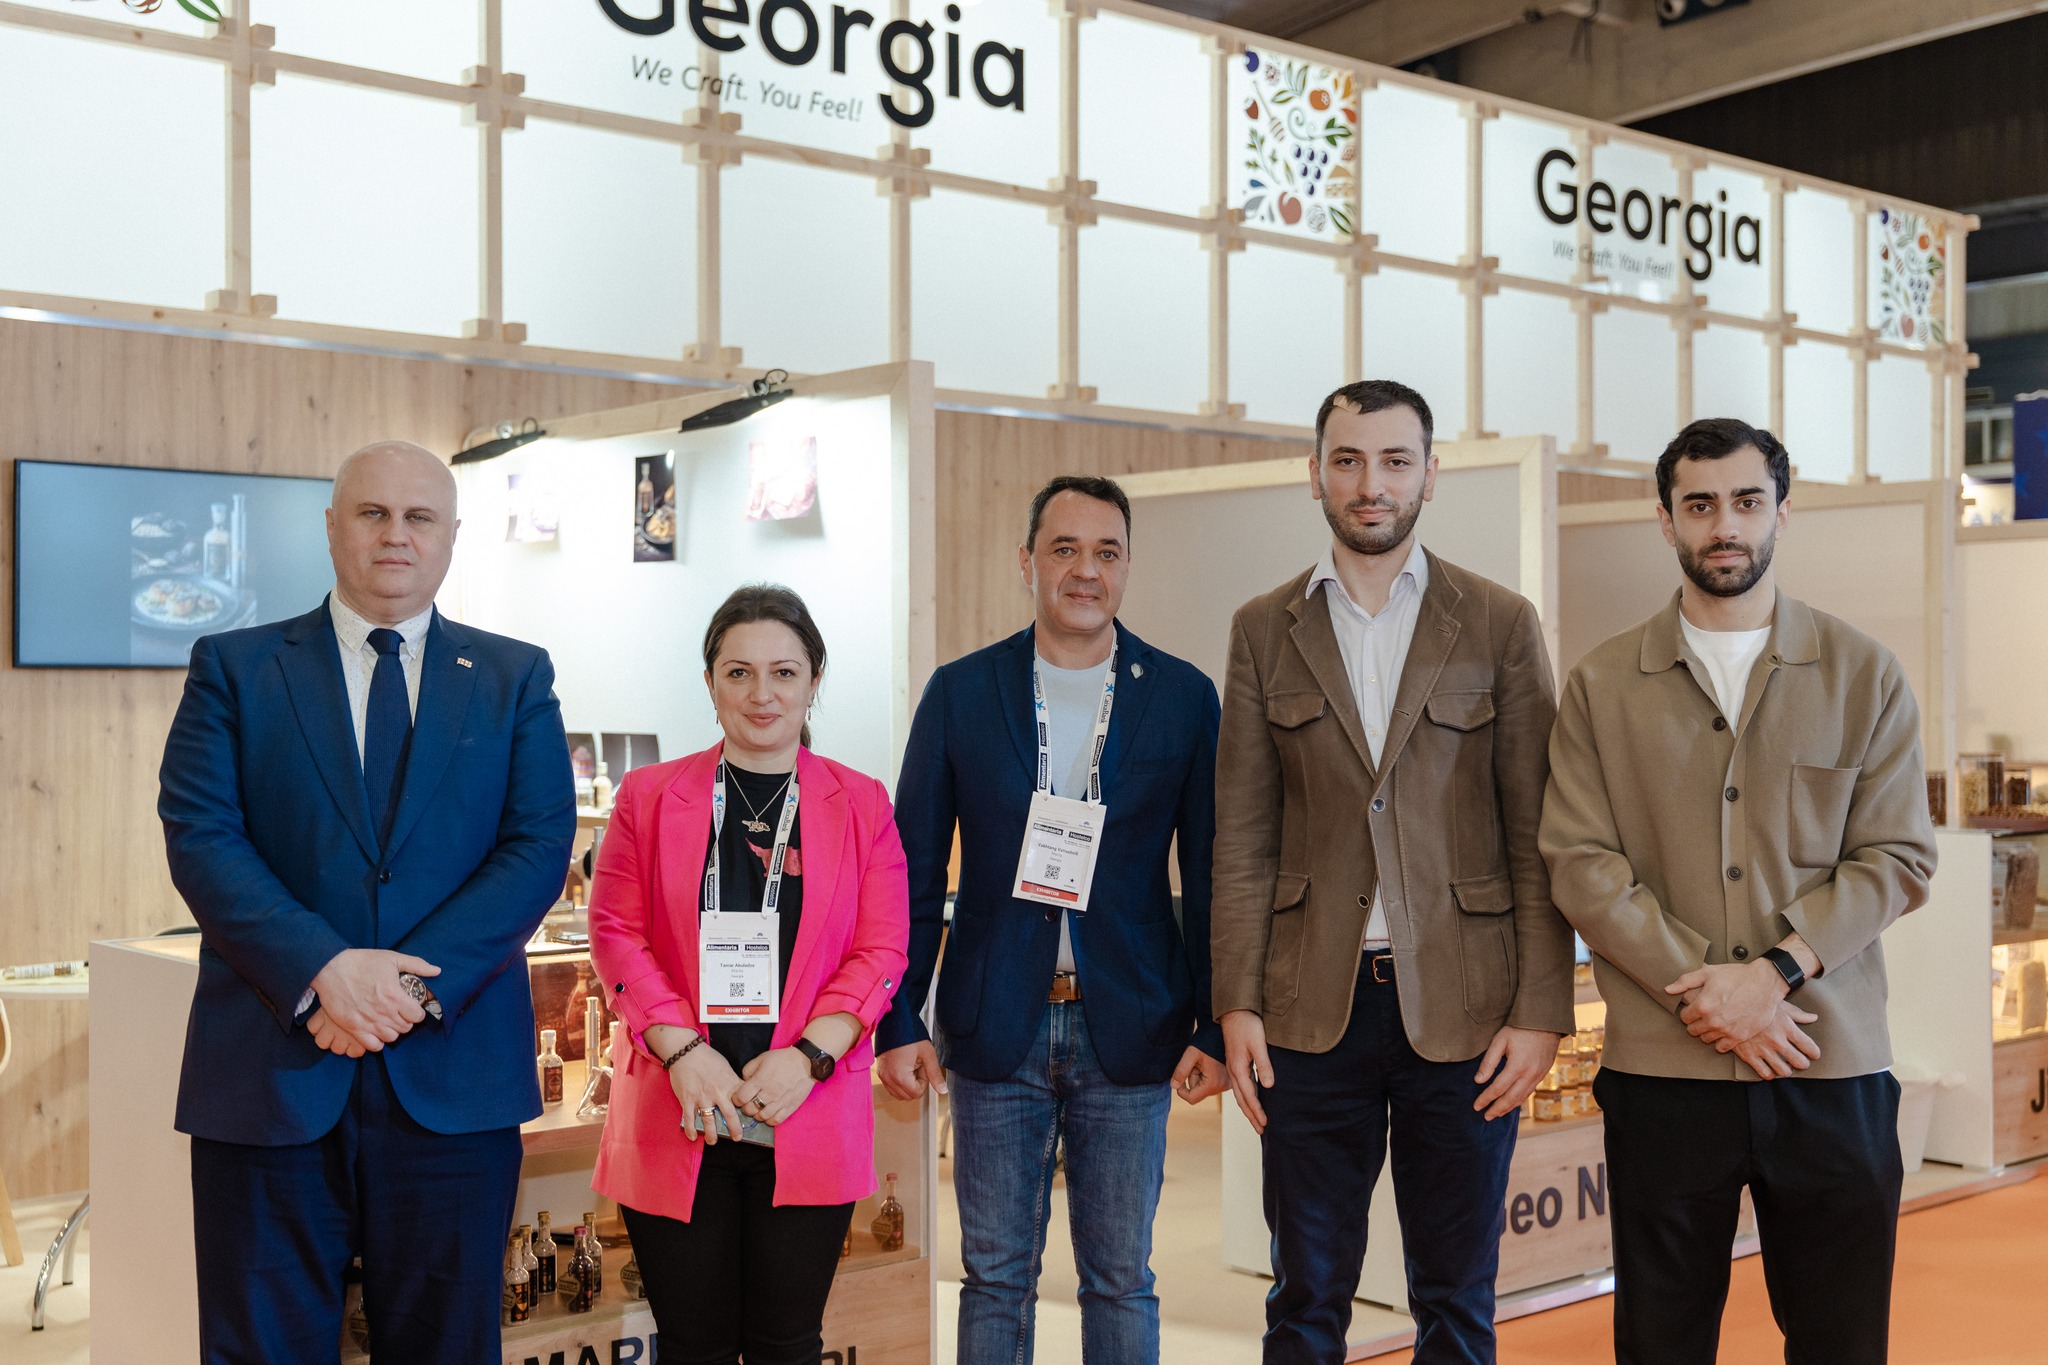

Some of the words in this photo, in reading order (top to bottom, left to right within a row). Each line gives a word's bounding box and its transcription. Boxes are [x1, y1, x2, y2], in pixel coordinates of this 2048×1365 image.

[631, 54, 673, 86] We
[681, 66, 747, 102] Craft.
[759, 80, 801, 110] You
[808, 91, 864, 123] Feel!
[1536, 148, 1761, 281] Georgia
[1553, 239, 1576, 258] We
[1618, 253, 1643, 272] You
[1101, 694, 1113, 724] CaixaBank
[1039, 754, 1047, 790] Alimentaria
[767, 881, 777, 907] Hostelco
[2030, 1068, 2048, 1114] J
[1501, 1186, 1563, 1235] eo
